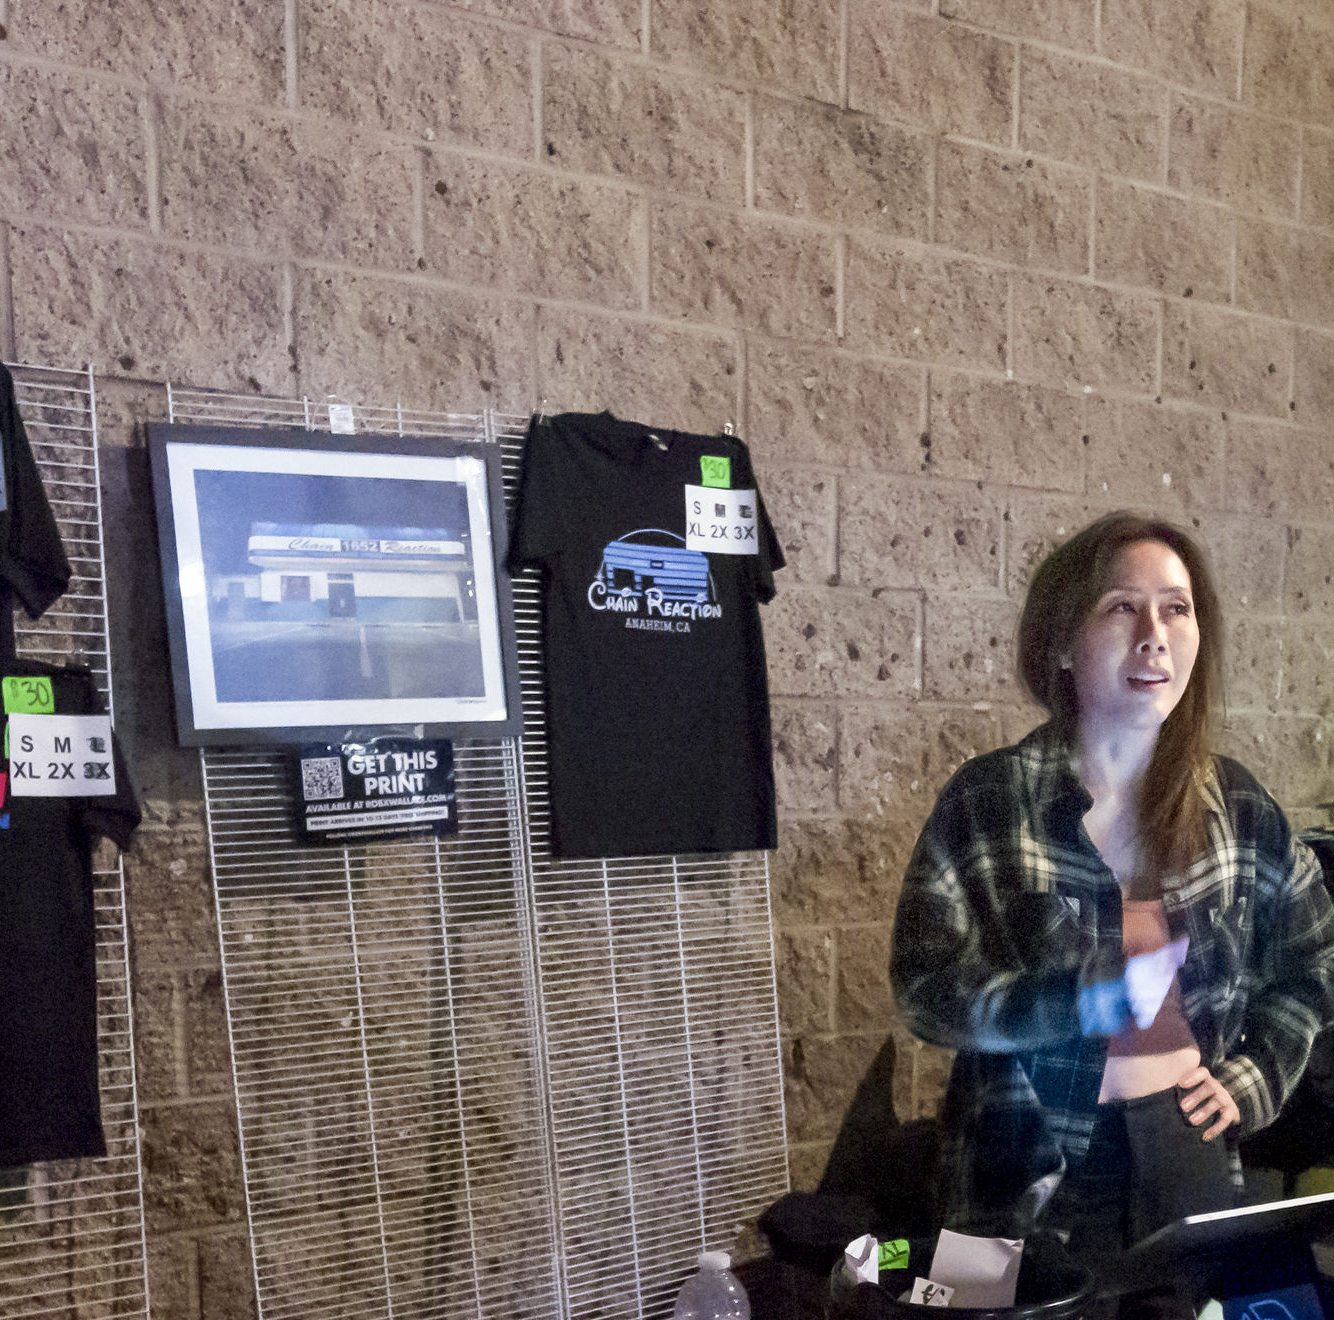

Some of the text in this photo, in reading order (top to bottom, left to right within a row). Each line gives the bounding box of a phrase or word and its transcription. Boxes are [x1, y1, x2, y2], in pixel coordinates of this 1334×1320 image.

[693, 500, 702, 515] S
[688, 521, 755, 541] XL 2X 3X
[676, 622, 692, 633] CA
[20, 735, 35, 754] S
[53, 736, 73, 754] M
[12, 761, 41, 780] XL
[48, 762, 76, 780] 2X
[347, 750, 439, 776] GET THIS
[364, 772, 426, 796] PRINT
[305, 801, 352, 814] AVAILABLE
